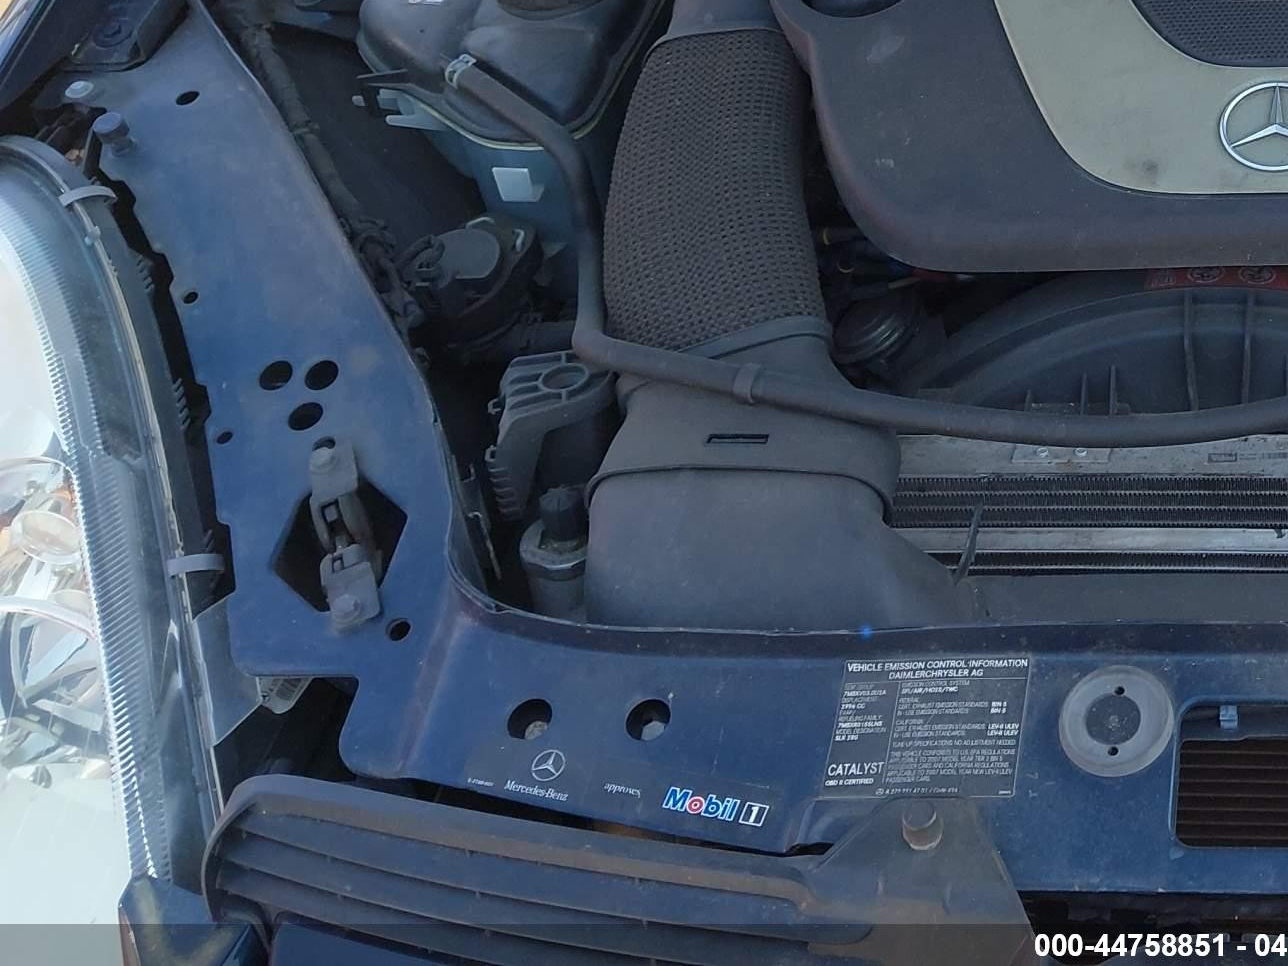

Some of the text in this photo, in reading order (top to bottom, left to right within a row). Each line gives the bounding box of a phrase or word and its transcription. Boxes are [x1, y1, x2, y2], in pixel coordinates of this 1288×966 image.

[848, 659, 1028, 672] VEHICLE EMISSION CONTROL INFORMATION
[888, 669, 984, 680] DAIMLERCHRYSLER AG
[828, 762, 884, 776] CATALYST
[504, 780, 568, 801] Mercedes-Benz
[662, 787, 740, 821] Mobil
